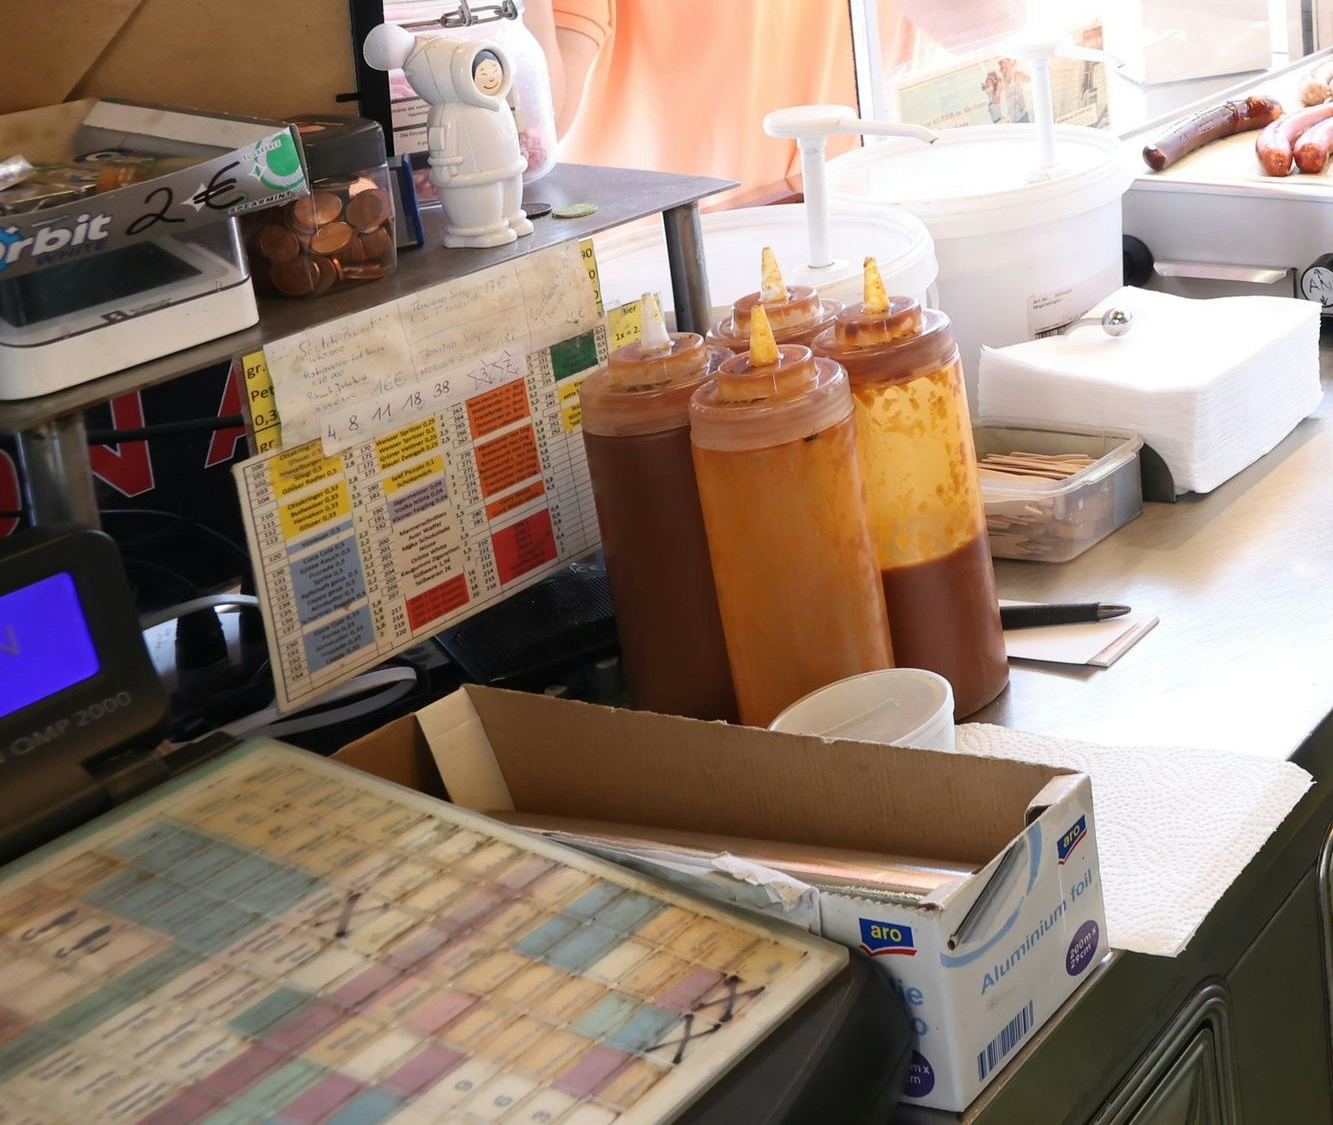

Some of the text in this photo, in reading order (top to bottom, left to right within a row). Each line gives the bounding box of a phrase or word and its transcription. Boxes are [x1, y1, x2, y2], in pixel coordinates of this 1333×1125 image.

[126, 187, 186, 236] 2
[228, 190, 293, 216] SPEARMINT
[1308, 275, 1333, 293] AN
[348, 414, 360, 432] 8
[371, 402, 392, 421] 11
[433, 380, 451, 399] 38
[74, 690, 132, 728] 2000
[1062, 823, 1083, 850] aro
[869, 922, 903, 943] aro
[980, 871, 1093, 996] Aluminium foil
